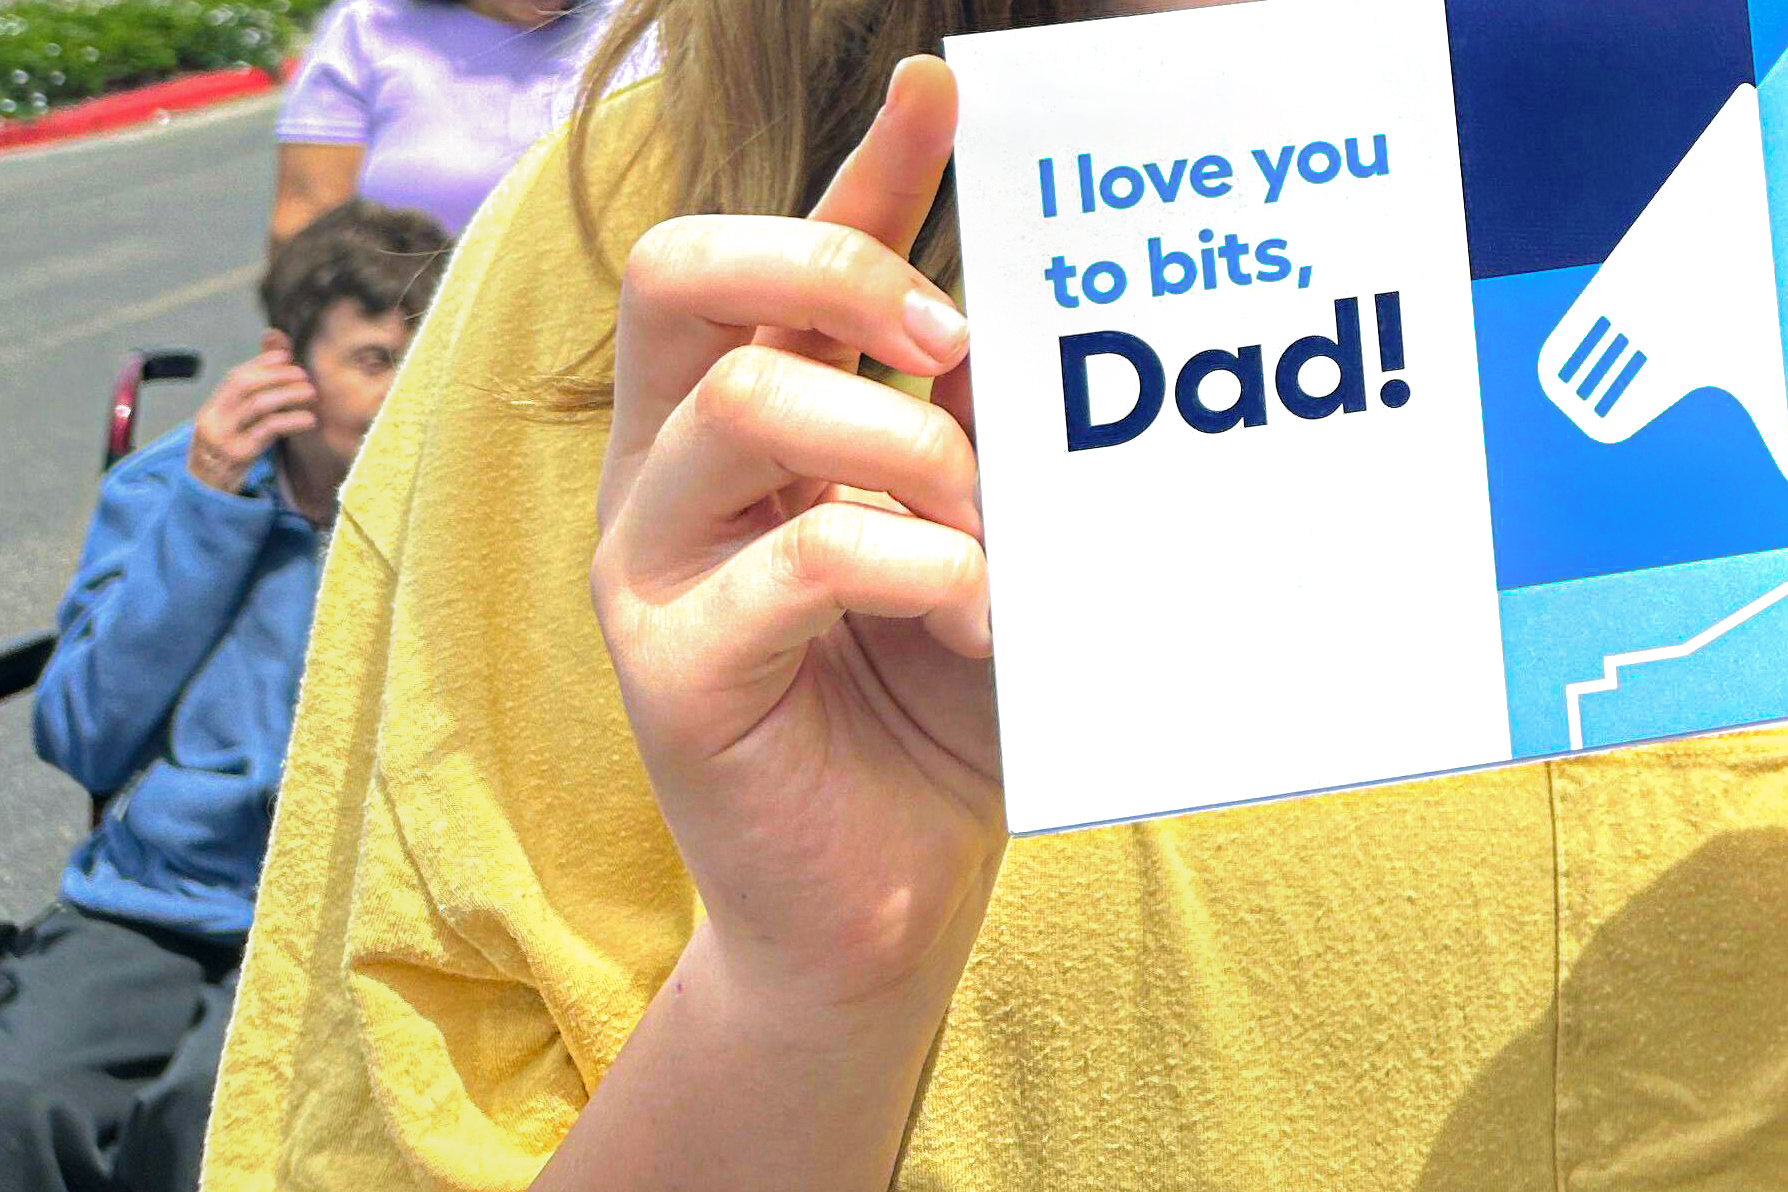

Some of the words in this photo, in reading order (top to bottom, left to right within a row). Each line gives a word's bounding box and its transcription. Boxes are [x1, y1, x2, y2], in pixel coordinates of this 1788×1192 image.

[1038, 157, 1058, 218] I
[1077, 153, 1234, 214] love
[1251, 133, 1390, 204] you
[1044, 255, 1128, 309] to
[1147, 228, 1313, 298] bits,
[1058, 290, 1411, 453] Dad!
